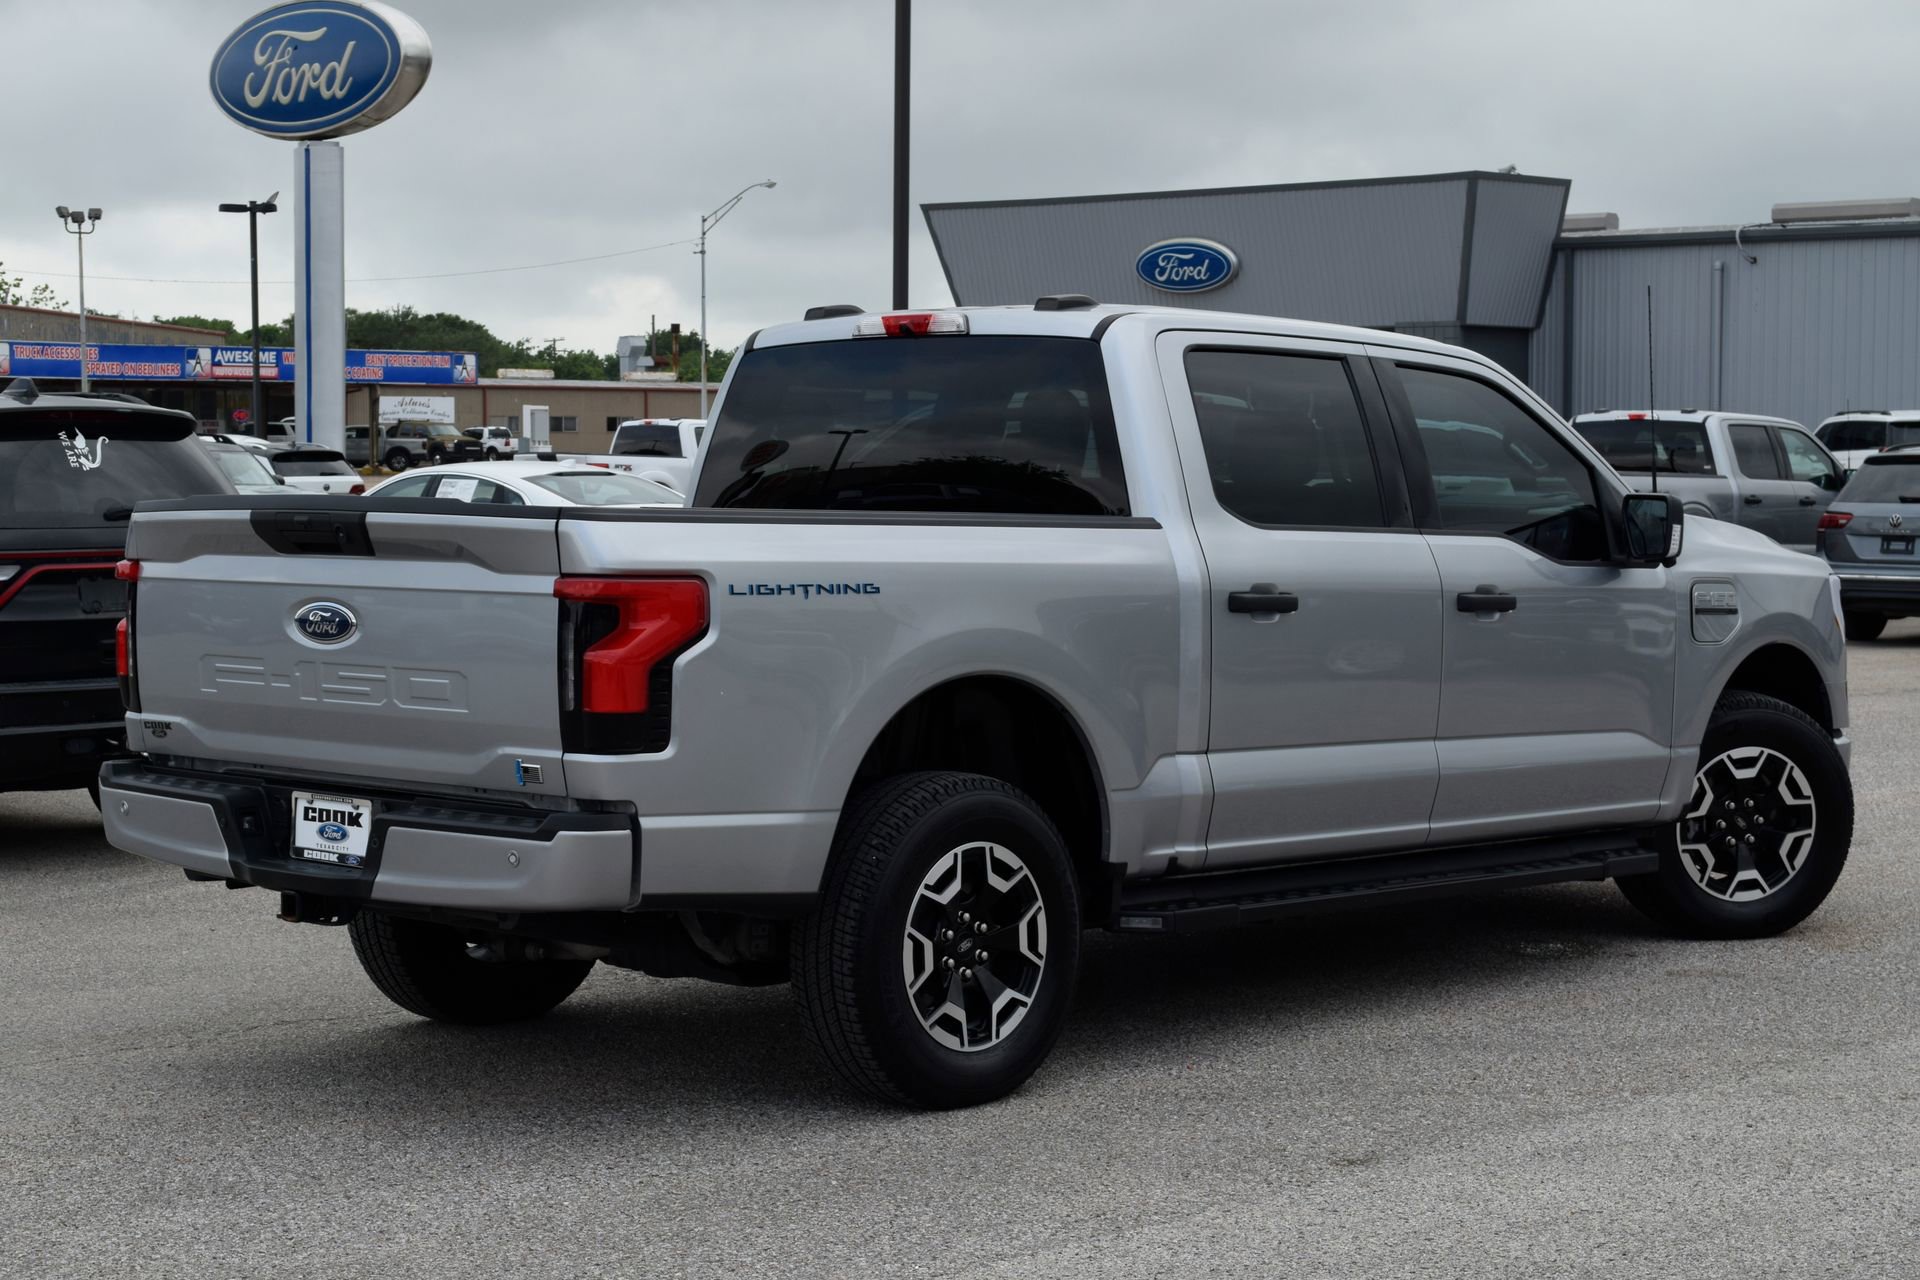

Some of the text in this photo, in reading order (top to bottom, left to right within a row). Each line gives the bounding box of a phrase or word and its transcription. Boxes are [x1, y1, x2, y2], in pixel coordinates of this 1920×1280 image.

[244, 26, 357, 108] Ford
[1155, 253, 1210, 281] Ford
[14, 345, 99, 363] TRUCK ACCESSOIES
[365, 353, 387, 366] PAINT
[388, 354, 433, 367] PROTECTION
[86, 362, 181, 377] SPRAYED ON BEDLINERS
[351, 366, 384, 380] COATING
[57, 430, 80, 468] WE ARE
[728, 583, 881, 600] LIGHTNING
[306, 610, 340, 634] Ford
[199, 653, 470, 713] F-150
[144, 721, 173, 730] COOK
[303, 806, 364, 828] COOK
[322, 825, 343, 840] Ford
[303, 849, 339, 862] COOK
